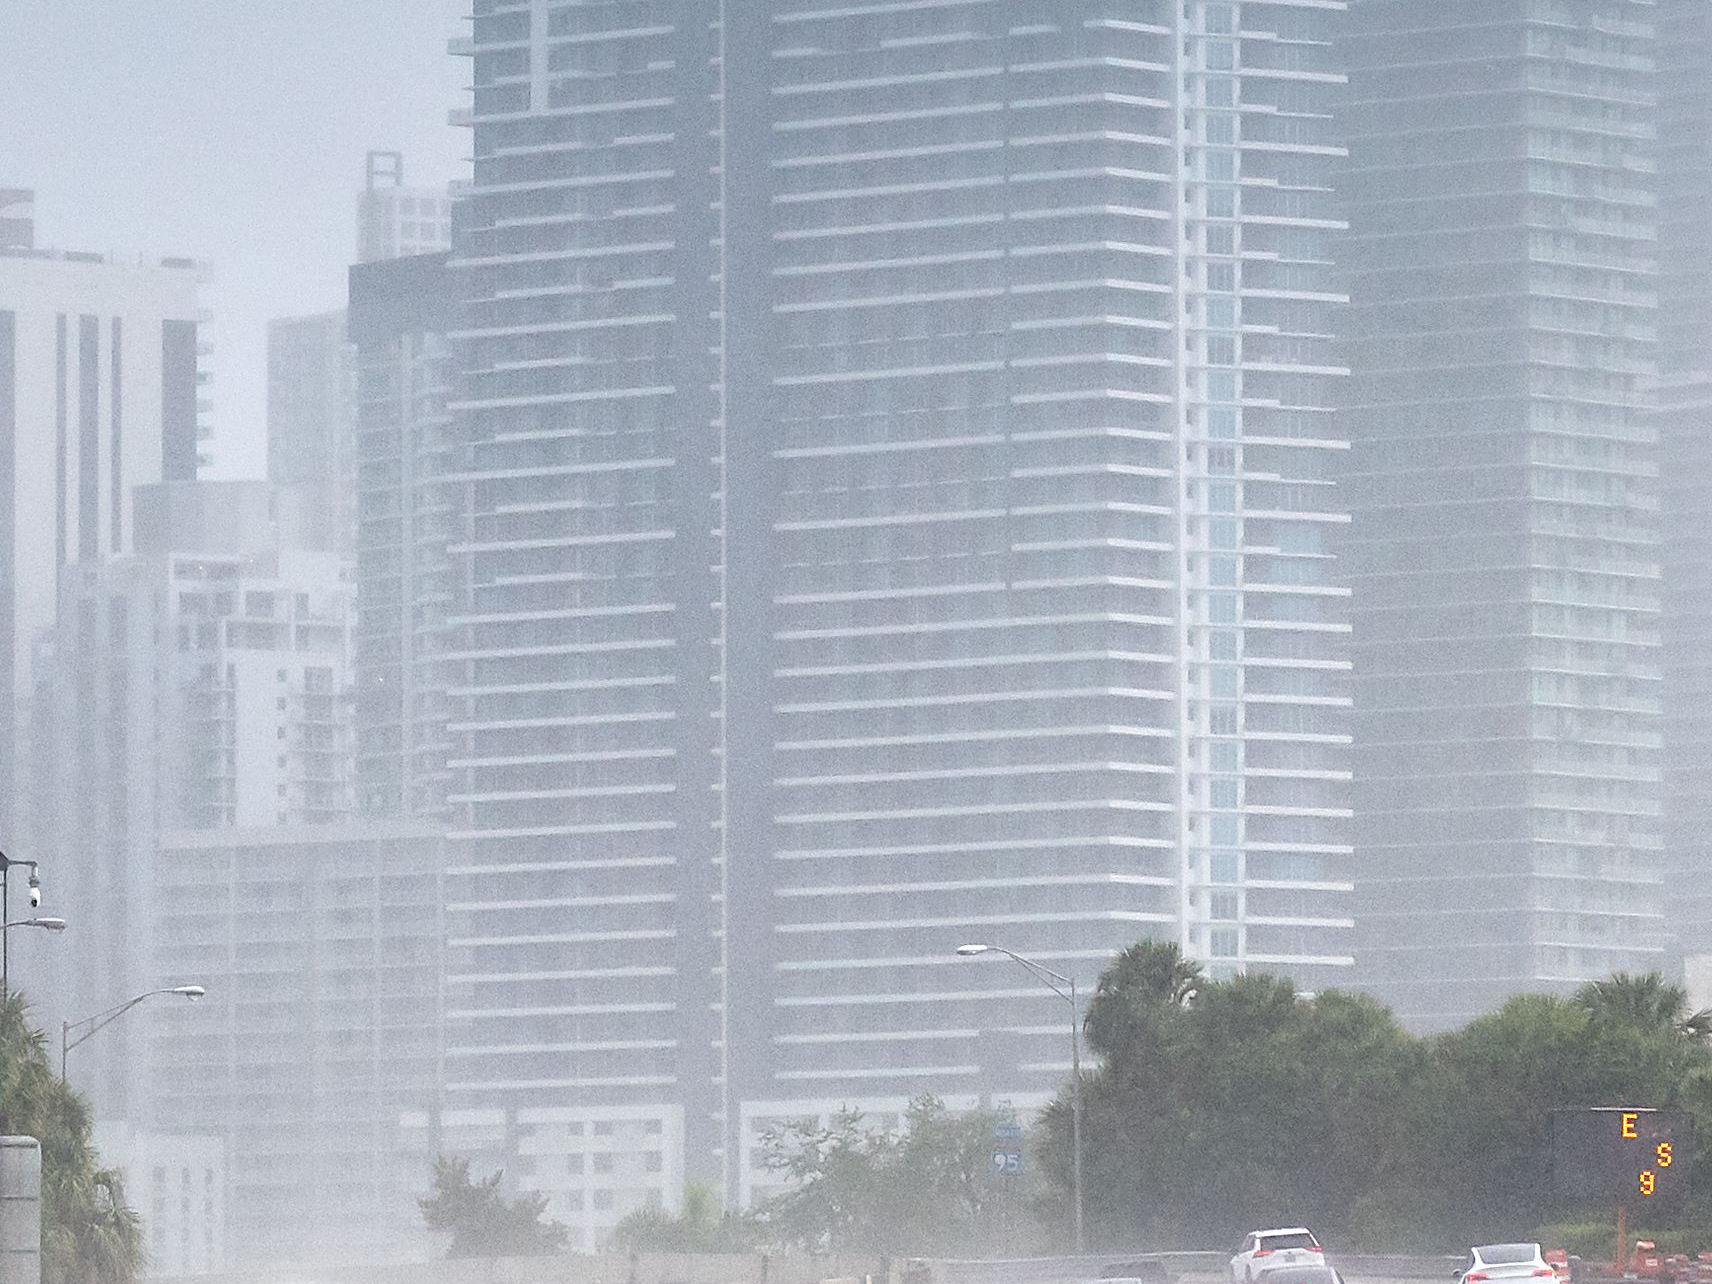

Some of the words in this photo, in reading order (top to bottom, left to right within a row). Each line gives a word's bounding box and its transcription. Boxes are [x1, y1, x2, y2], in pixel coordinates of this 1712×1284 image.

[1622, 1113, 1638, 1138] E
[994, 1154, 1018, 1171] 95
[1656, 1142, 1672, 1167] S
[1639, 1170, 1655, 1194] 9
